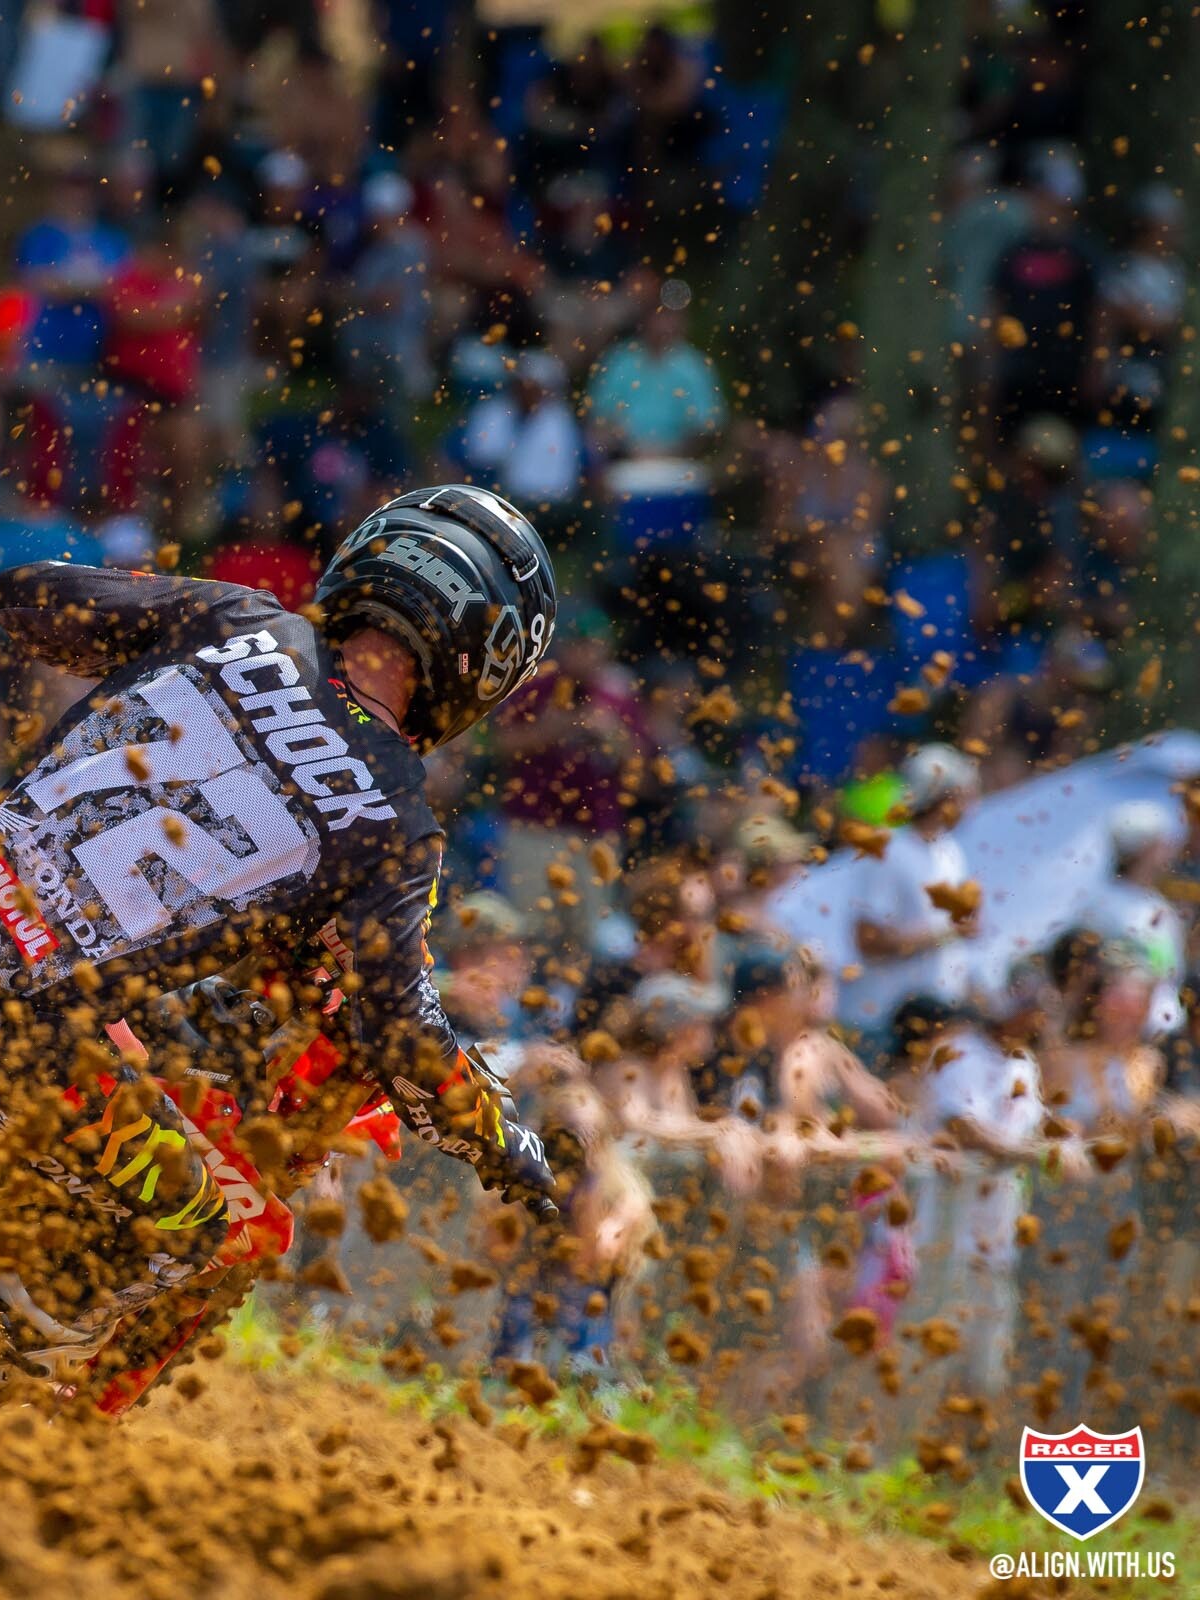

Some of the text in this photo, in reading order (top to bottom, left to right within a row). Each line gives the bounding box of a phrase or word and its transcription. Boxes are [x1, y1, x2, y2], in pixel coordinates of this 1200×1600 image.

[377, 537, 489, 624] SCHOCK
[195, 630, 398, 832] SCHOCK
[26, 669, 309, 943] 72
[184, 1067, 232, 1082] RENEGADE
[406, 1103, 484, 1165] HONDA
